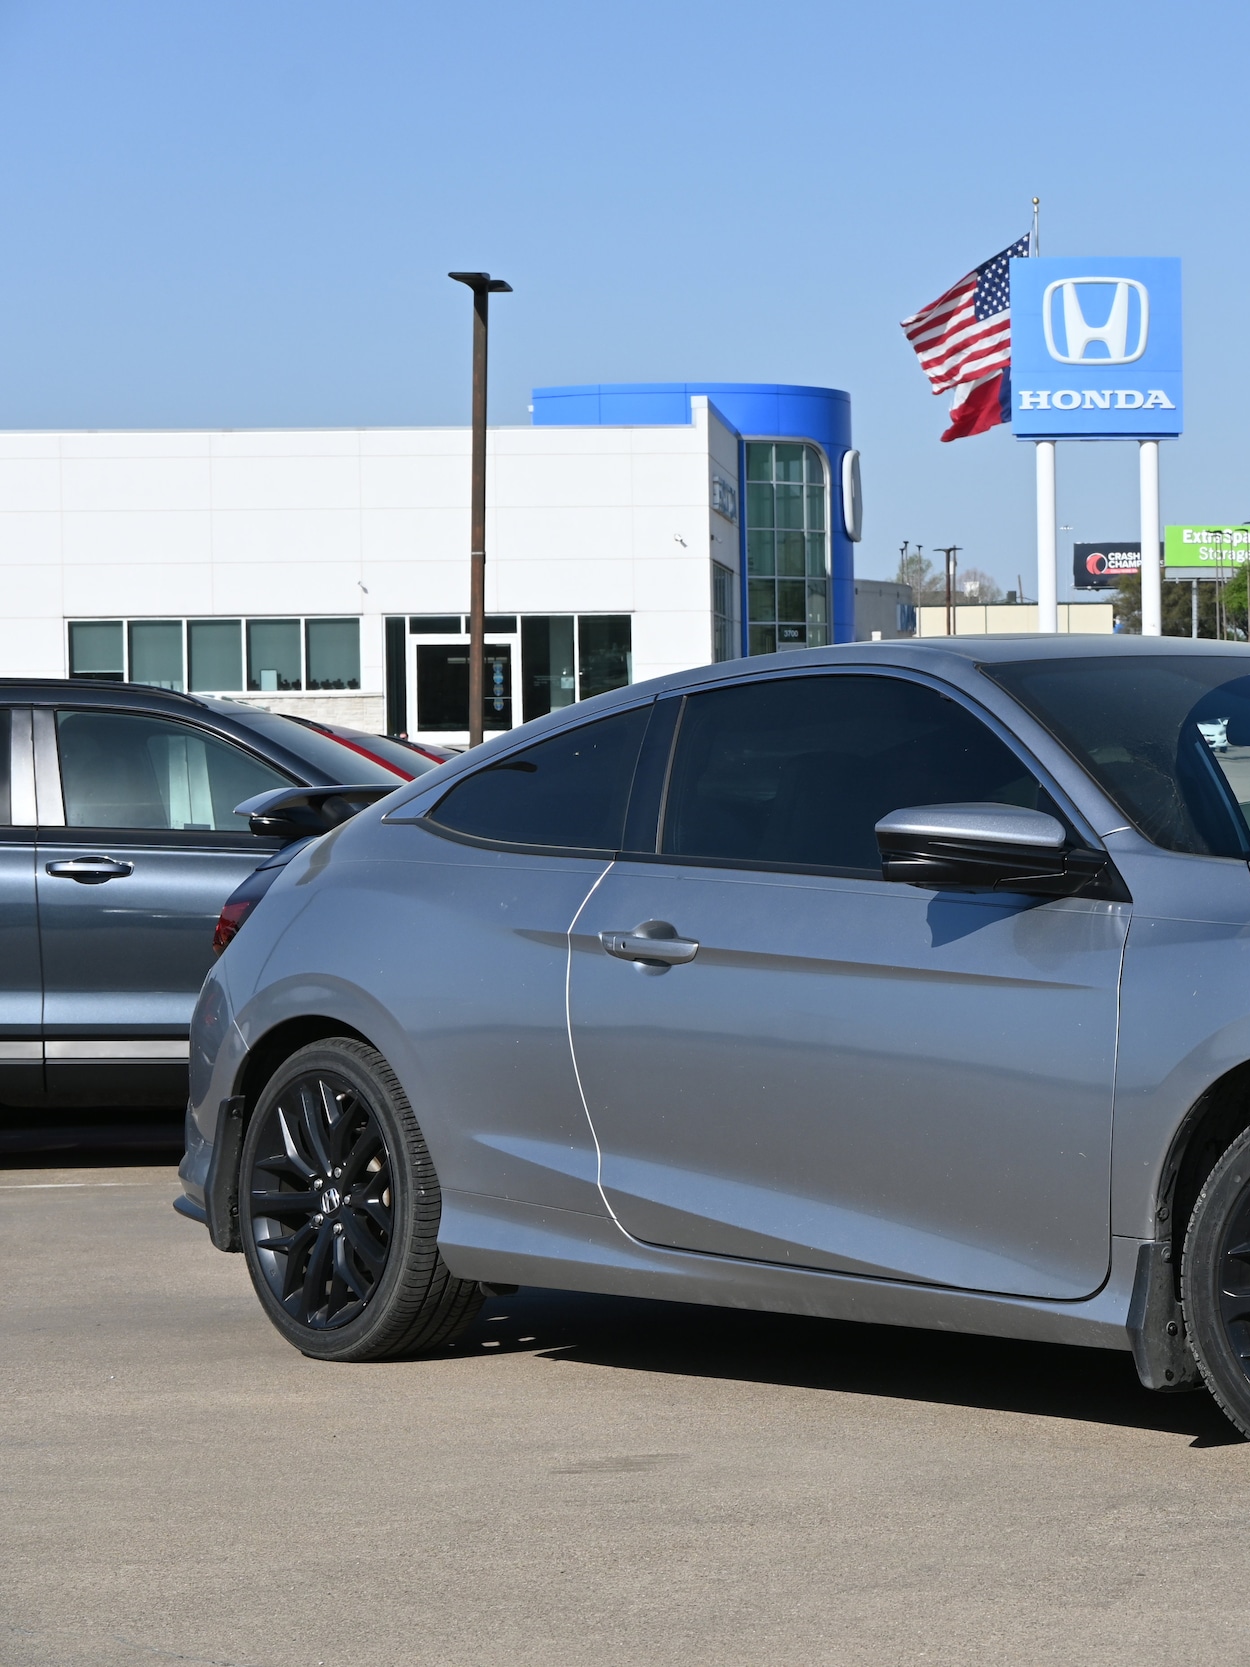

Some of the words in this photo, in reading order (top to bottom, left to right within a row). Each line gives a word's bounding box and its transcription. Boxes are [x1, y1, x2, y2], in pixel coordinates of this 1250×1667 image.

[1018, 389, 1177, 410] HONDA
[1107, 552, 1141, 561] CRASH
[783, 629, 799, 638] 3700
